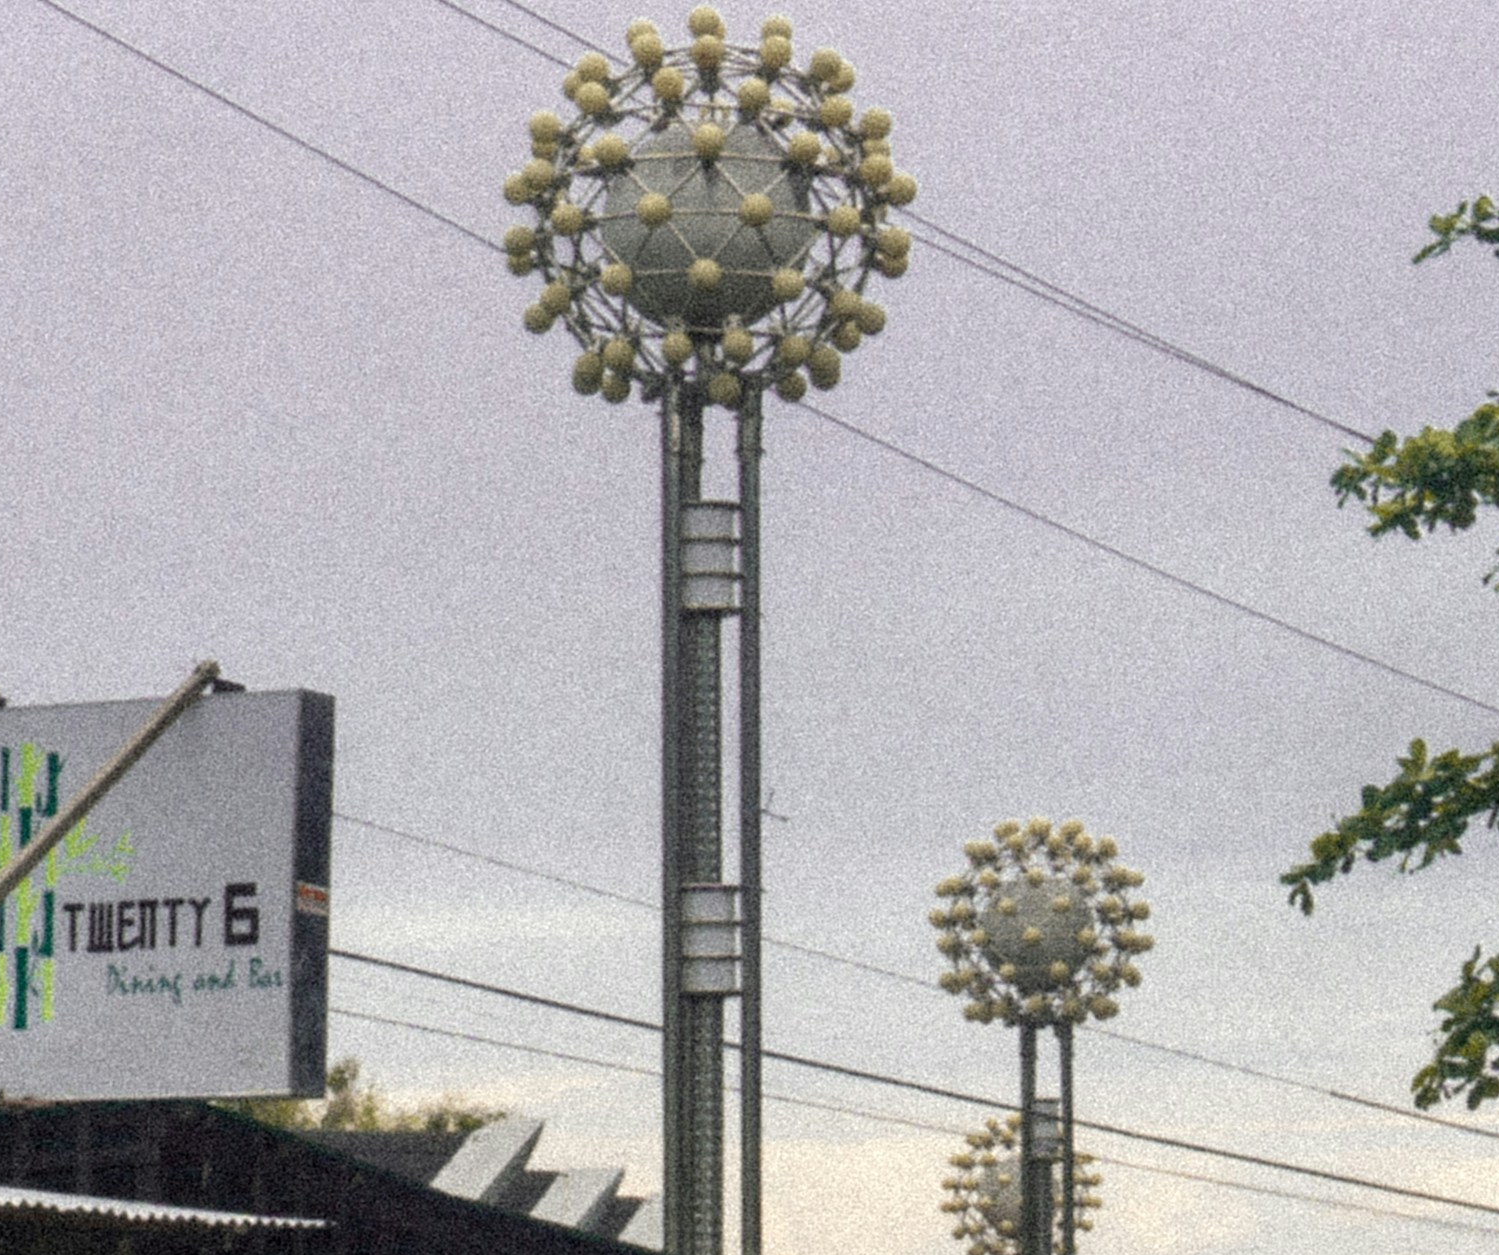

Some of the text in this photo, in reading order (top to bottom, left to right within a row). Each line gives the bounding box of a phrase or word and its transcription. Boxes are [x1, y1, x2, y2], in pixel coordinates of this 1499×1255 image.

[224, 881, 260, 946] 6
[106, 956, 284, 1005] Dining and Bar
